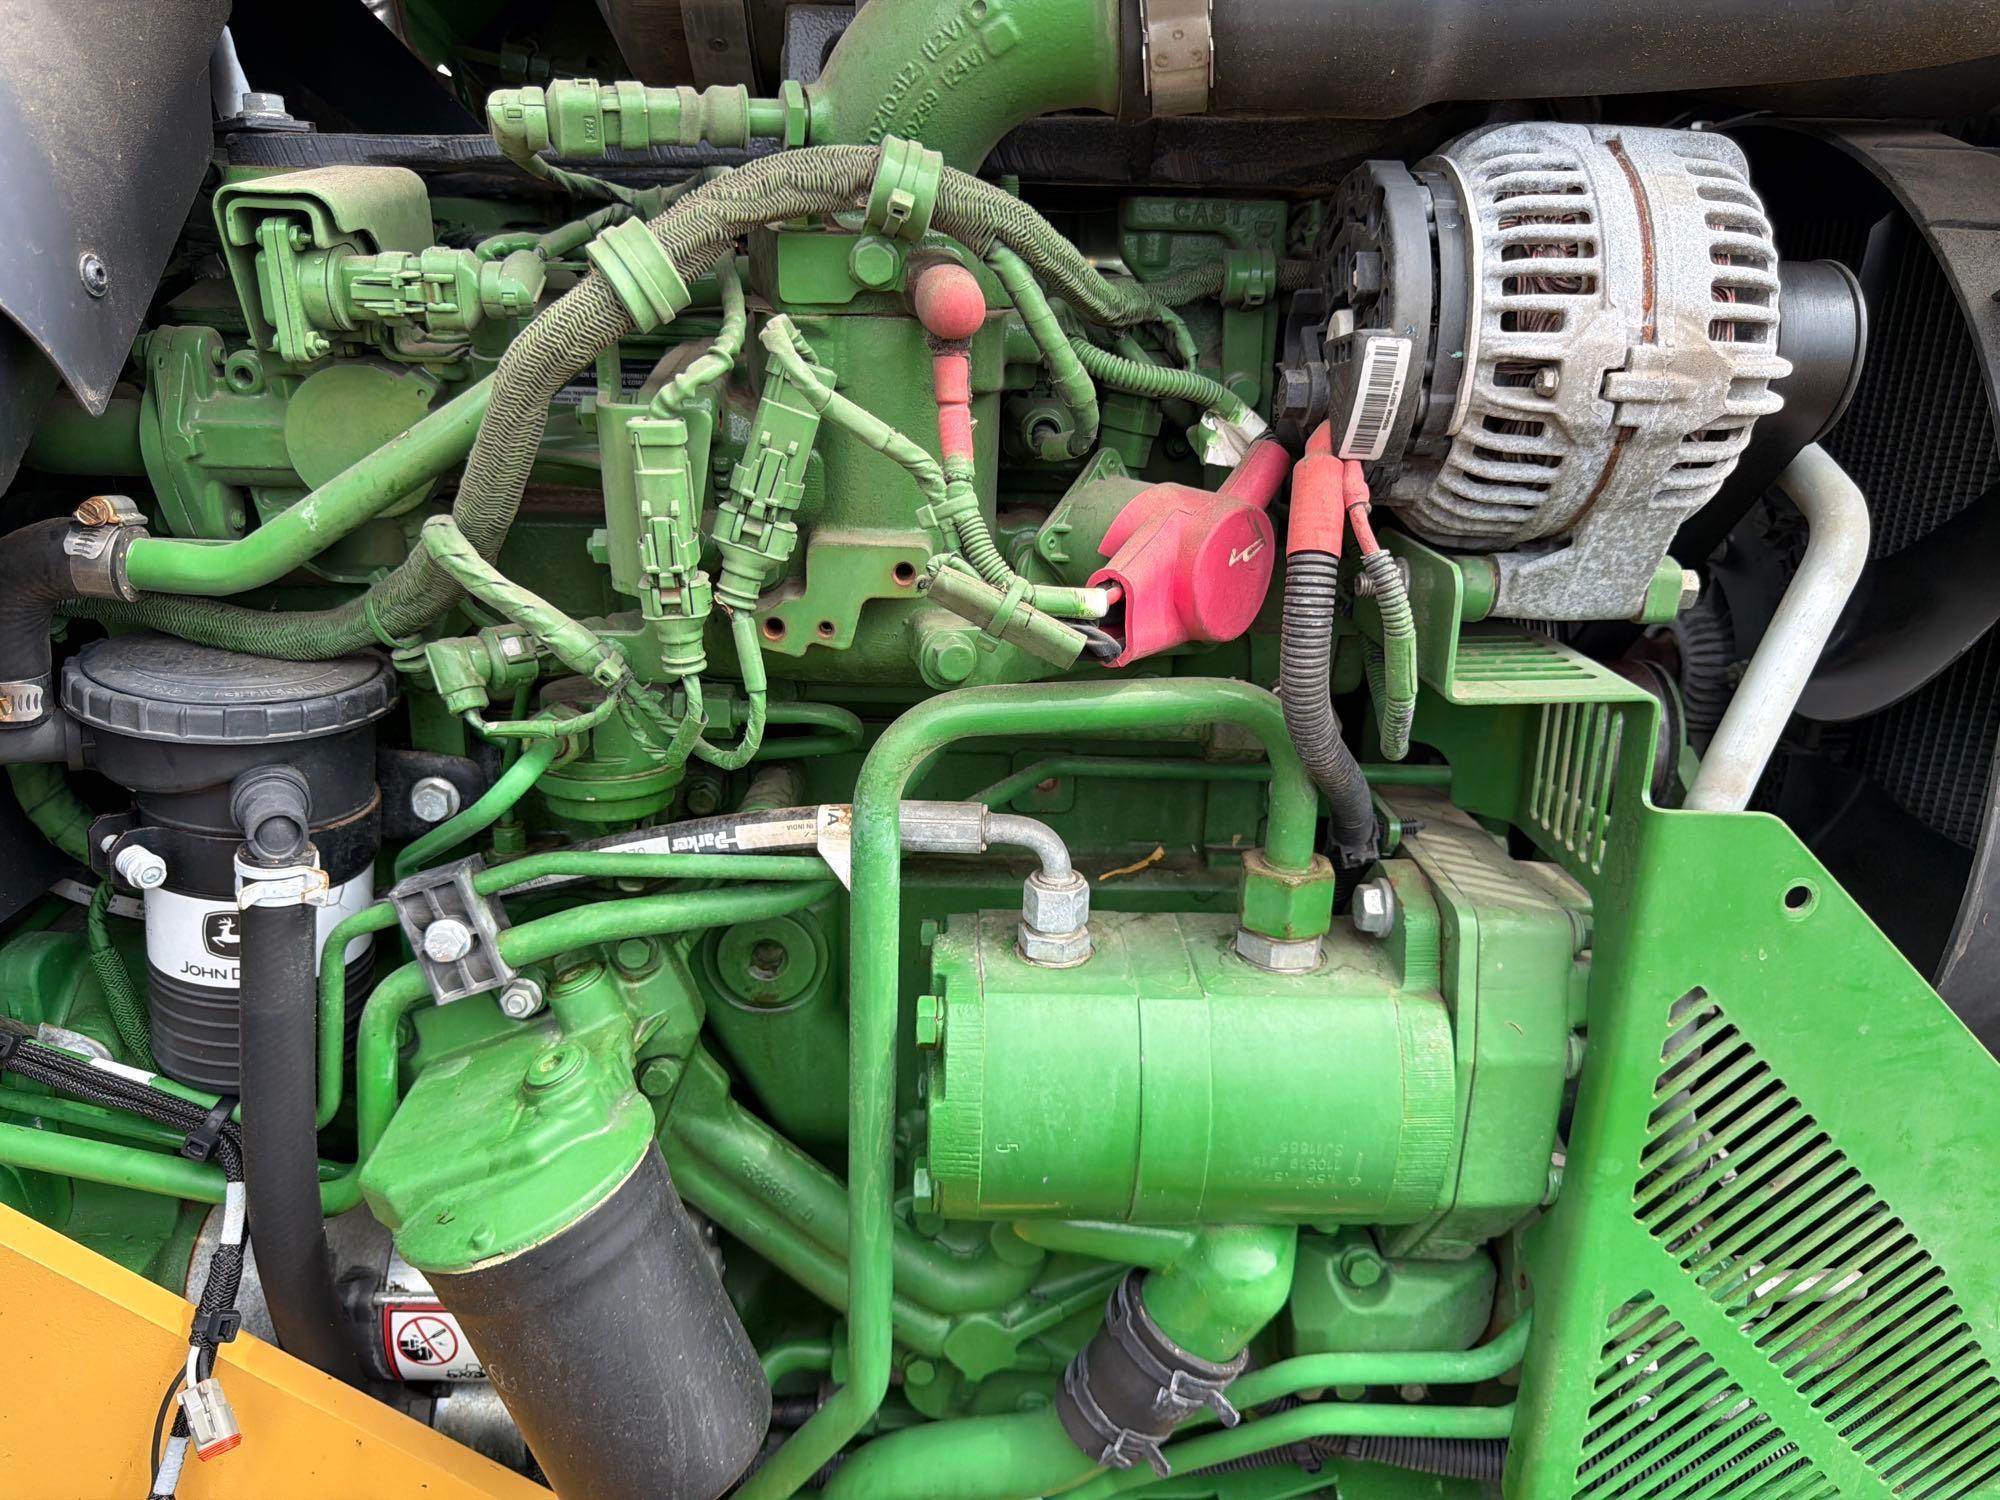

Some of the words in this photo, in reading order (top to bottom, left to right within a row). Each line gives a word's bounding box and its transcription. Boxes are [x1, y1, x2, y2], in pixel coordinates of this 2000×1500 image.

[1173, 201, 1243, 225] CAST
[786, 823, 805, 831] INDIA
[670, 830, 728, 852] Parker
[180, 960, 228, 980] JOHN
